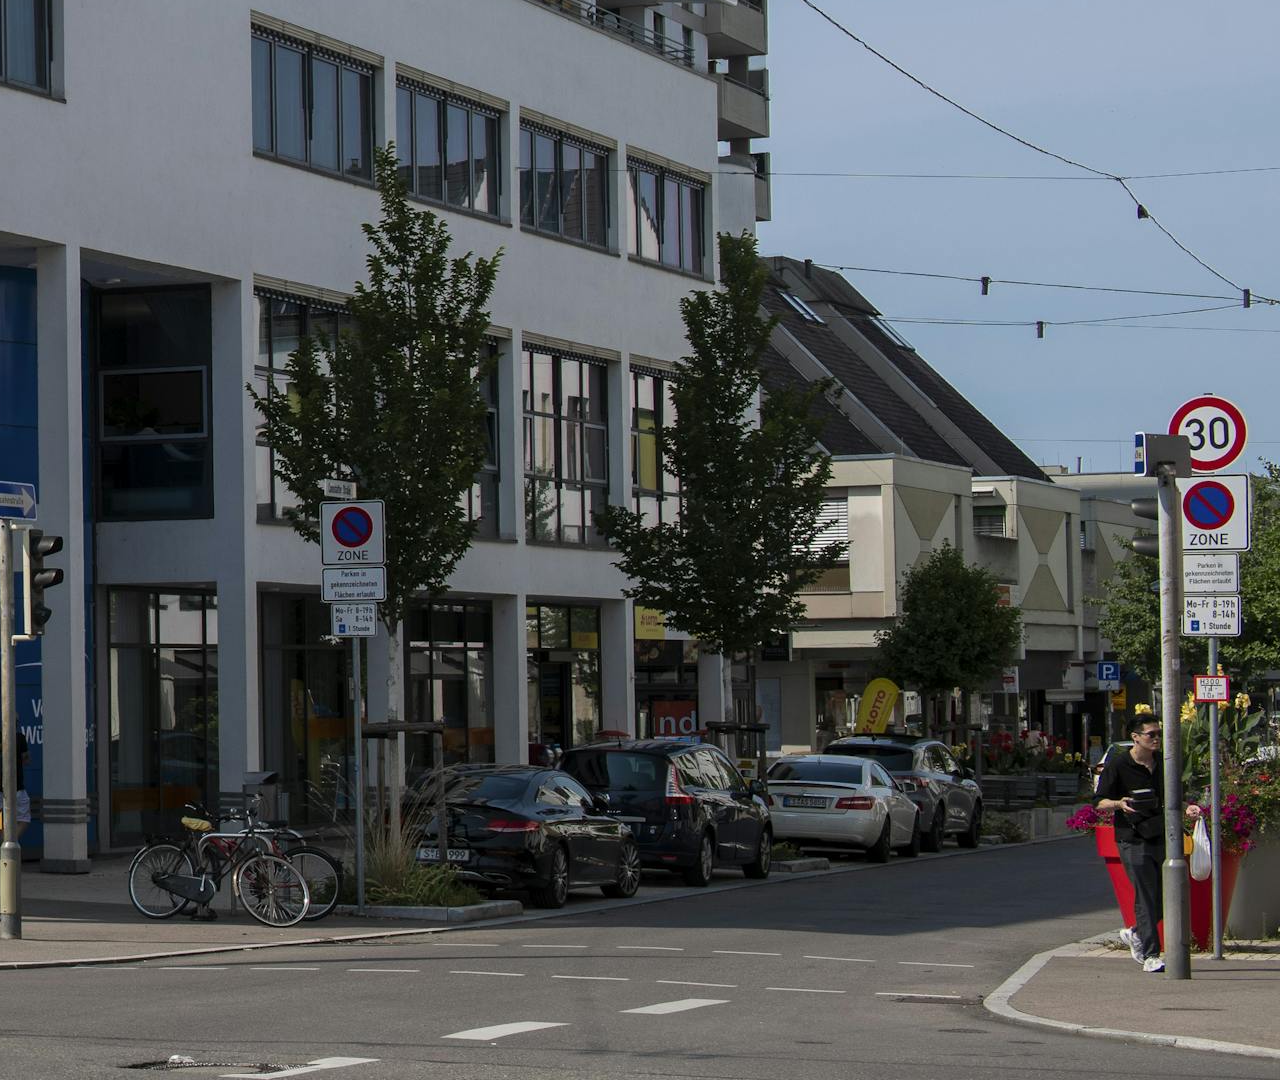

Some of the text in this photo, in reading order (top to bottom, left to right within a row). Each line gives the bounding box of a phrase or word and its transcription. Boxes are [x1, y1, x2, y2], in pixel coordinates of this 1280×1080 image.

[1185, 416, 1230, 451] 30
[1189, 533, 1229, 546] ZONE
[338, 550, 369, 561] ZONE
[341, 570, 367, 578] Parken in
[330, 580, 378, 590] gekennzeichneten
[334, 590, 376, 599] Flächen erlaubt
[1186, 600, 1209, 609] Mo-Fr
[335, 606, 353, 615] Mo-Fr
[1186, 610, 1196, 619] Sa
[335, 615, 343, 623] Sa
[1203, 622, 1231, 630] 1 Stunde
[871, 690, 886, 725] LOTTO
[448, 850, 466, 859] 999
